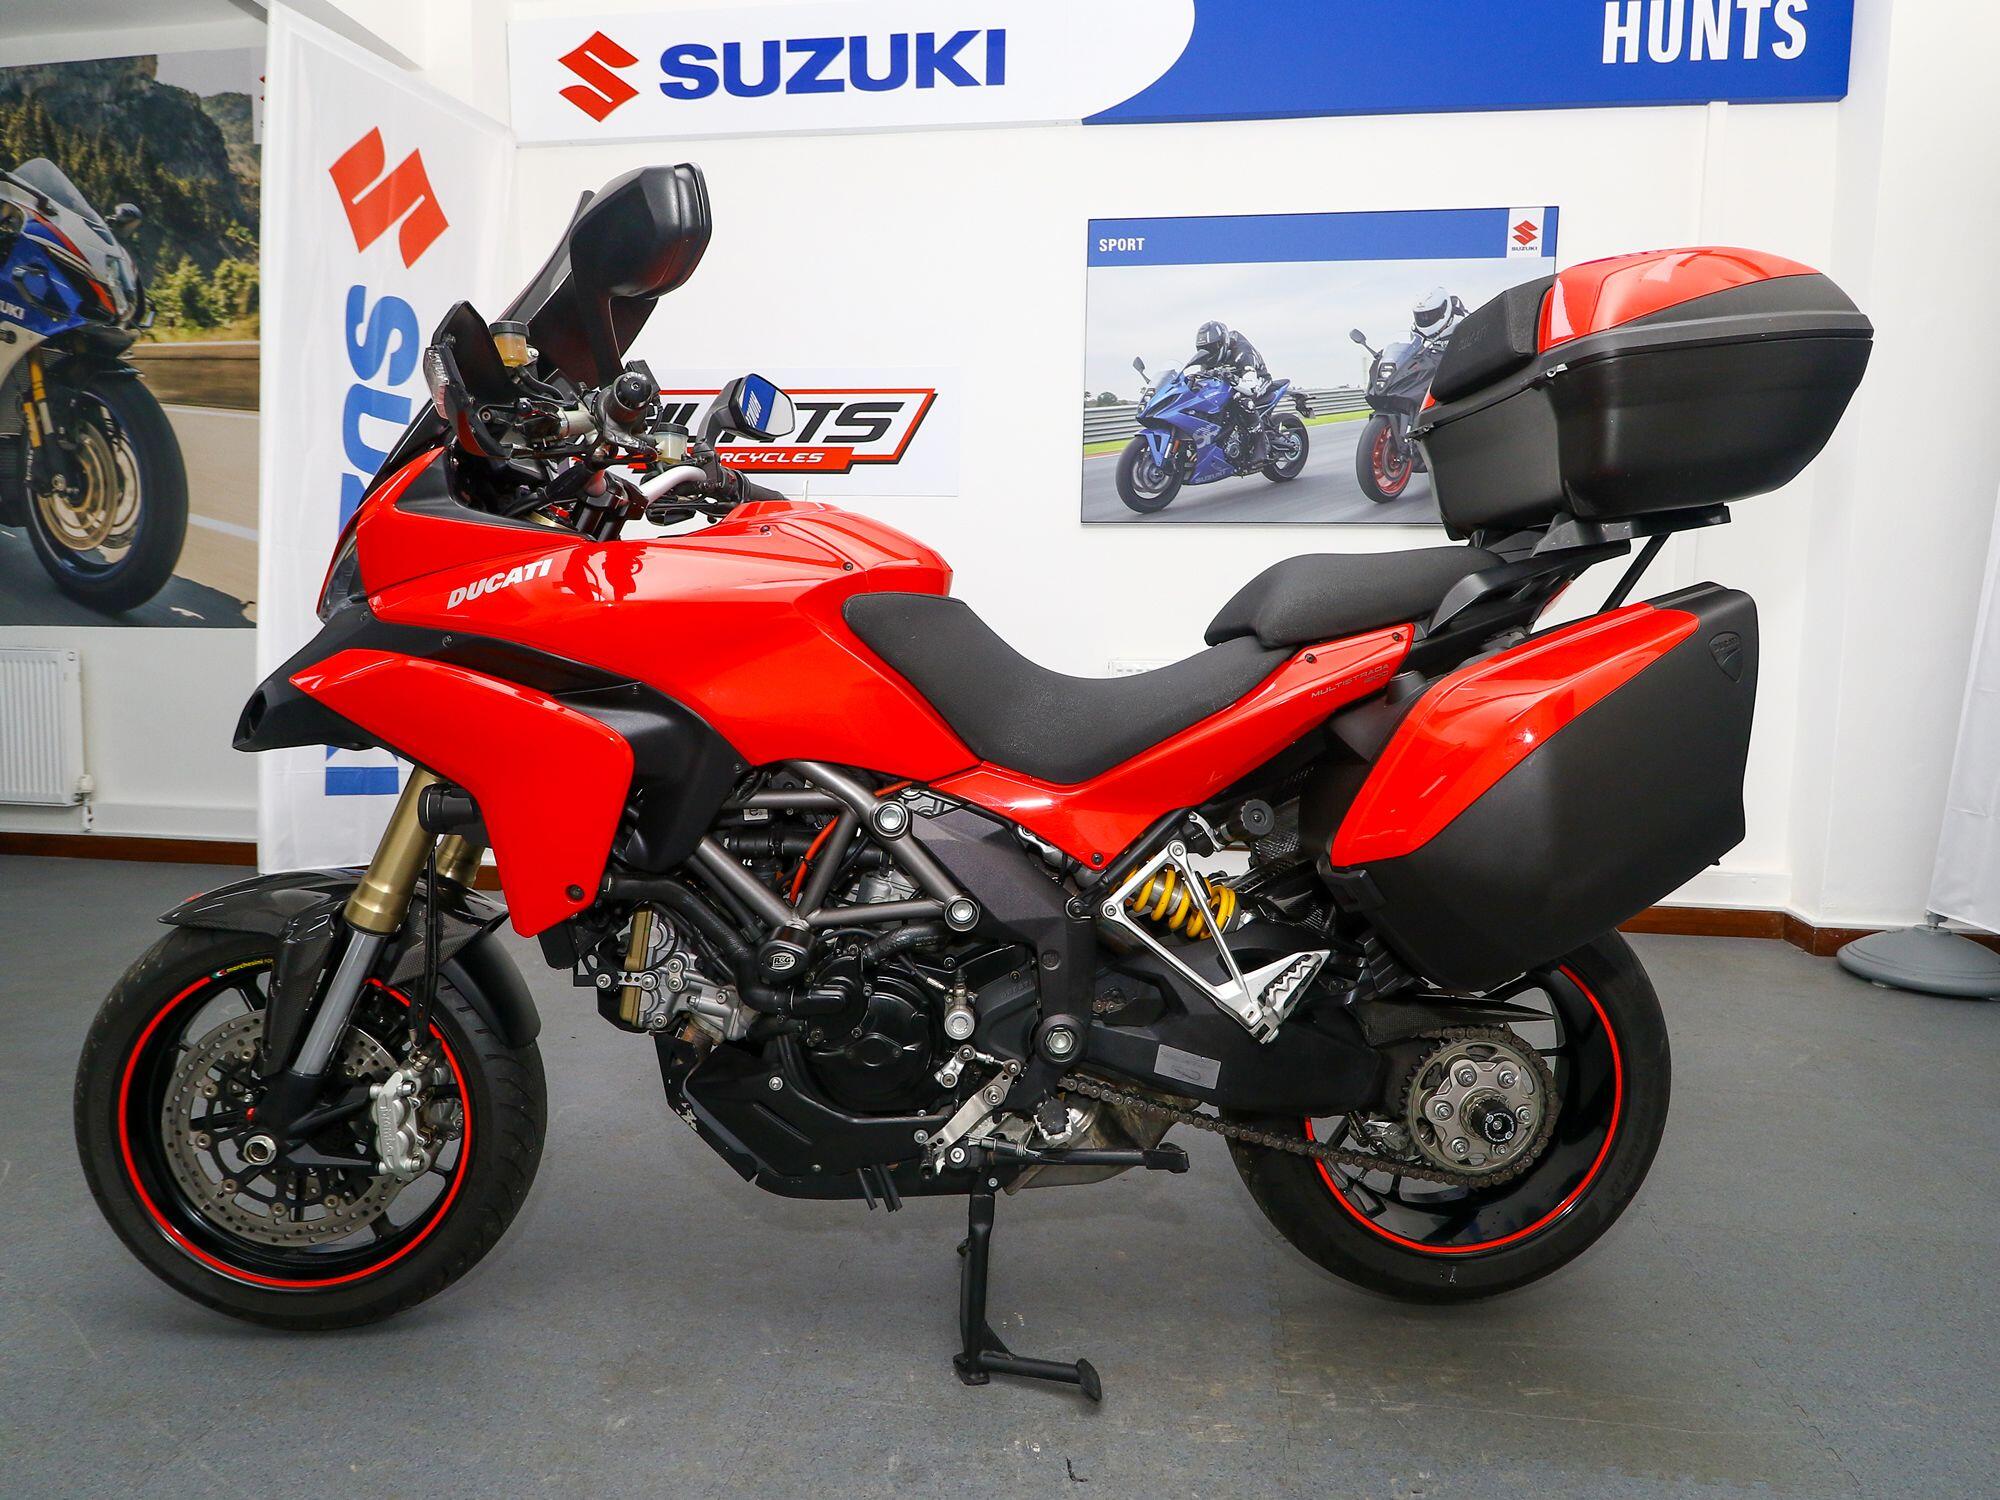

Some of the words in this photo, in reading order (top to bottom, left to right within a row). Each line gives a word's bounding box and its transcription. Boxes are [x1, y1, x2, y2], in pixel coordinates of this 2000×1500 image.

[1602, 0, 1808, 64] HUNTS
[659, 28, 1006, 100] SUZUKI
[1099, 237, 1145, 252] SPORT
[720, 452, 825, 463] RCYCLES
[446, 558, 553, 610] DUCATI
[1311, 663, 1390, 698] MULTISTRADA
